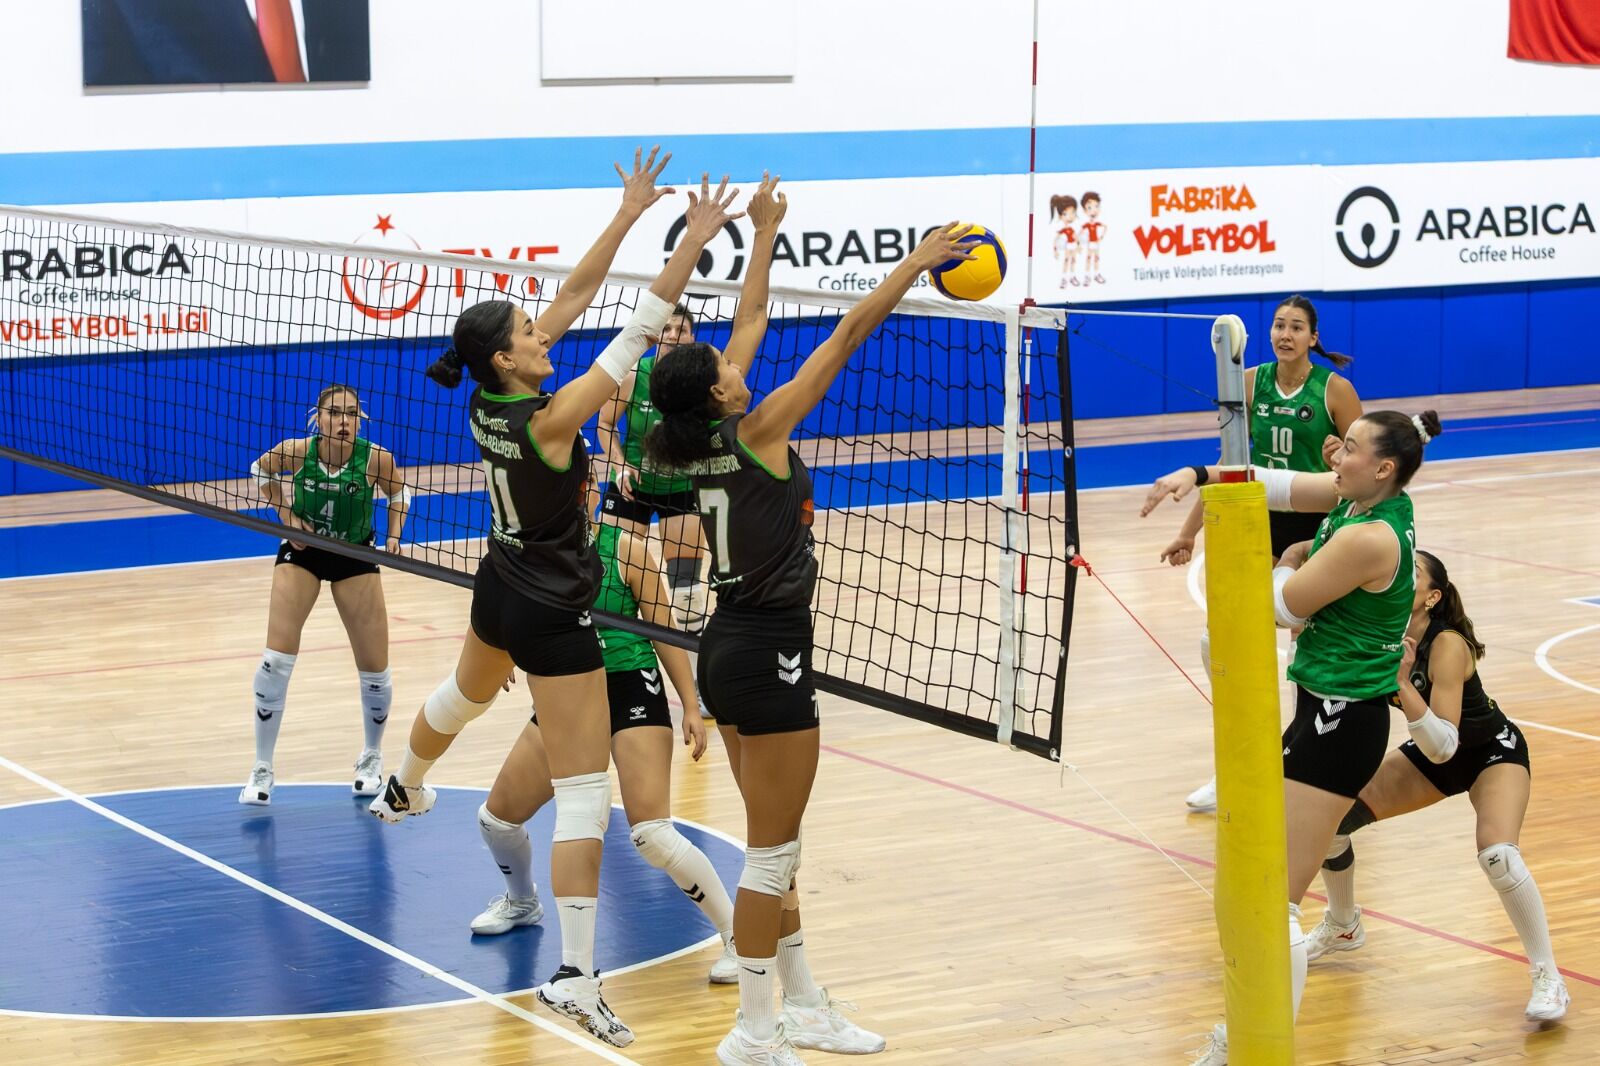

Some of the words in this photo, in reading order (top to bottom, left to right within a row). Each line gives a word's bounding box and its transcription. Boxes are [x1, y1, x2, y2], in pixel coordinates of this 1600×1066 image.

[1416, 203, 1596, 241] ARABICA
[771, 226, 944, 267] ARABI
[1133, 220, 1276, 259] VOLEYBOL
[0, 243, 191, 282] RABICA
[1459, 245, 1507, 263] Coffee
[1511, 245, 1556, 261] House
[818, 272, 878, 291] Coffee
[1133, 267, 1170, 282] Türkiye
[1173, 265, 1218, 280] Voleybol
[1220, 263, 1284, 277] Federasyonu
[19, 287, 79, 304] Coffee
[85, 286, 140, 302] House
[0, 314, 137, 342] VOLEYBOL
[1270, 426, 1293, 455] 10
[319, 500, 334, 521] 4
[482, 459, 522, 534] 11
[605, 499, 615, 509] 15
[699, 488, 730, 573] 7
